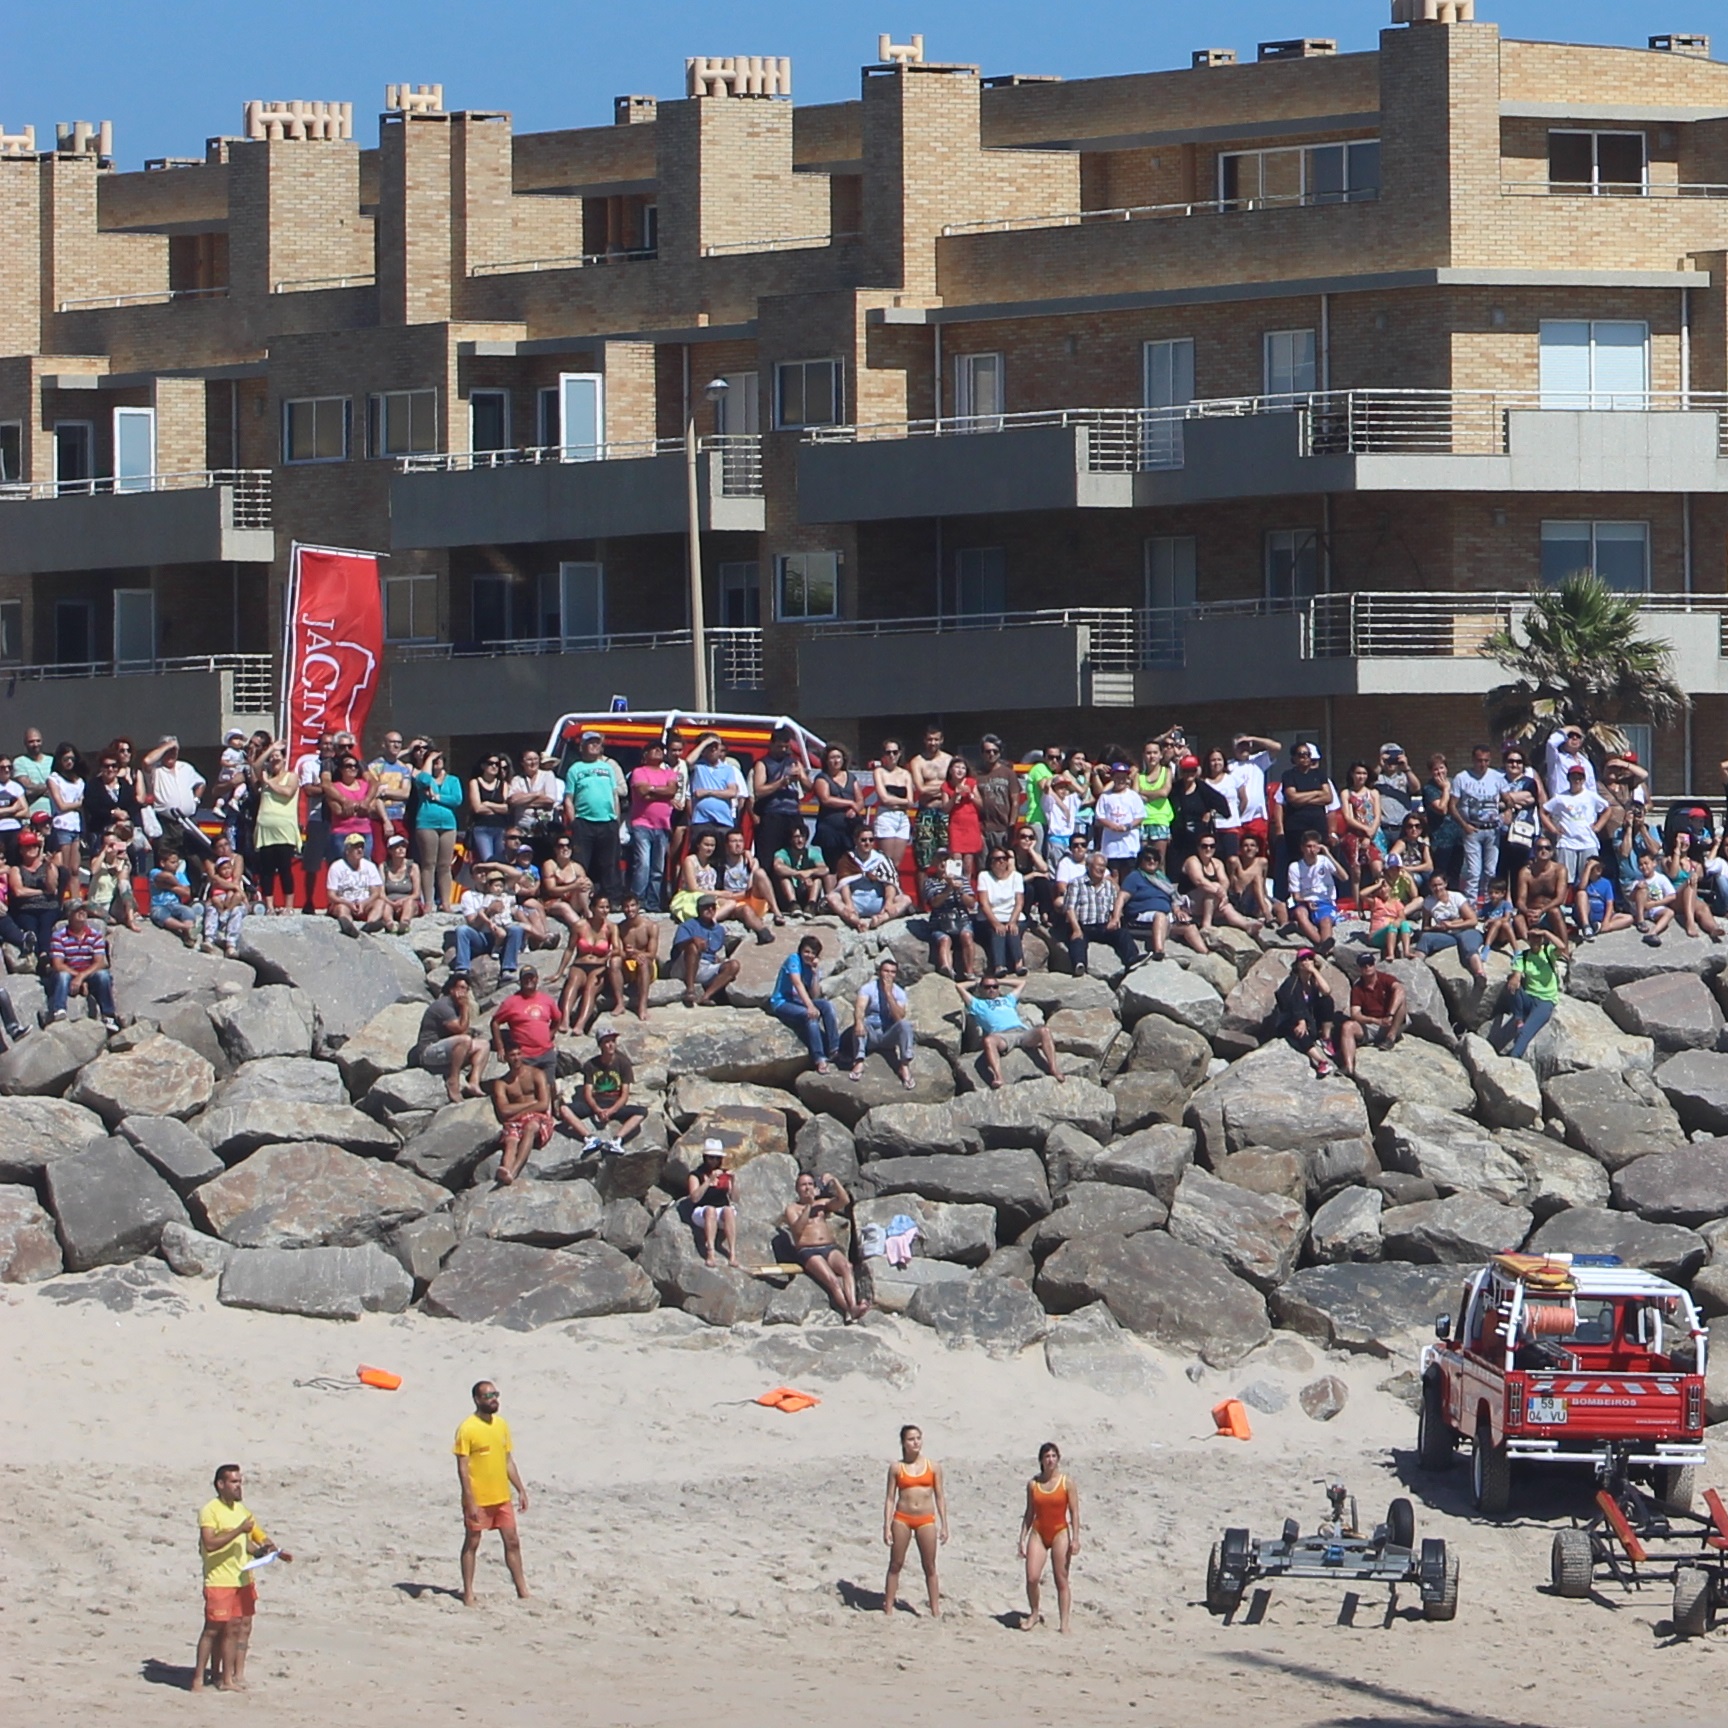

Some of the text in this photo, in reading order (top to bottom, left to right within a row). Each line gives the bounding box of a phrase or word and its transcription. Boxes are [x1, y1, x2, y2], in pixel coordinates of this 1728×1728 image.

[294, 612, 340, 774] JACINT
[1541, 1397, 1555, 1409] 59
[1571, 1398, 1637, 1407] BOMBEIROS
[1528, 1410, 1566, 1422] 04 VU
